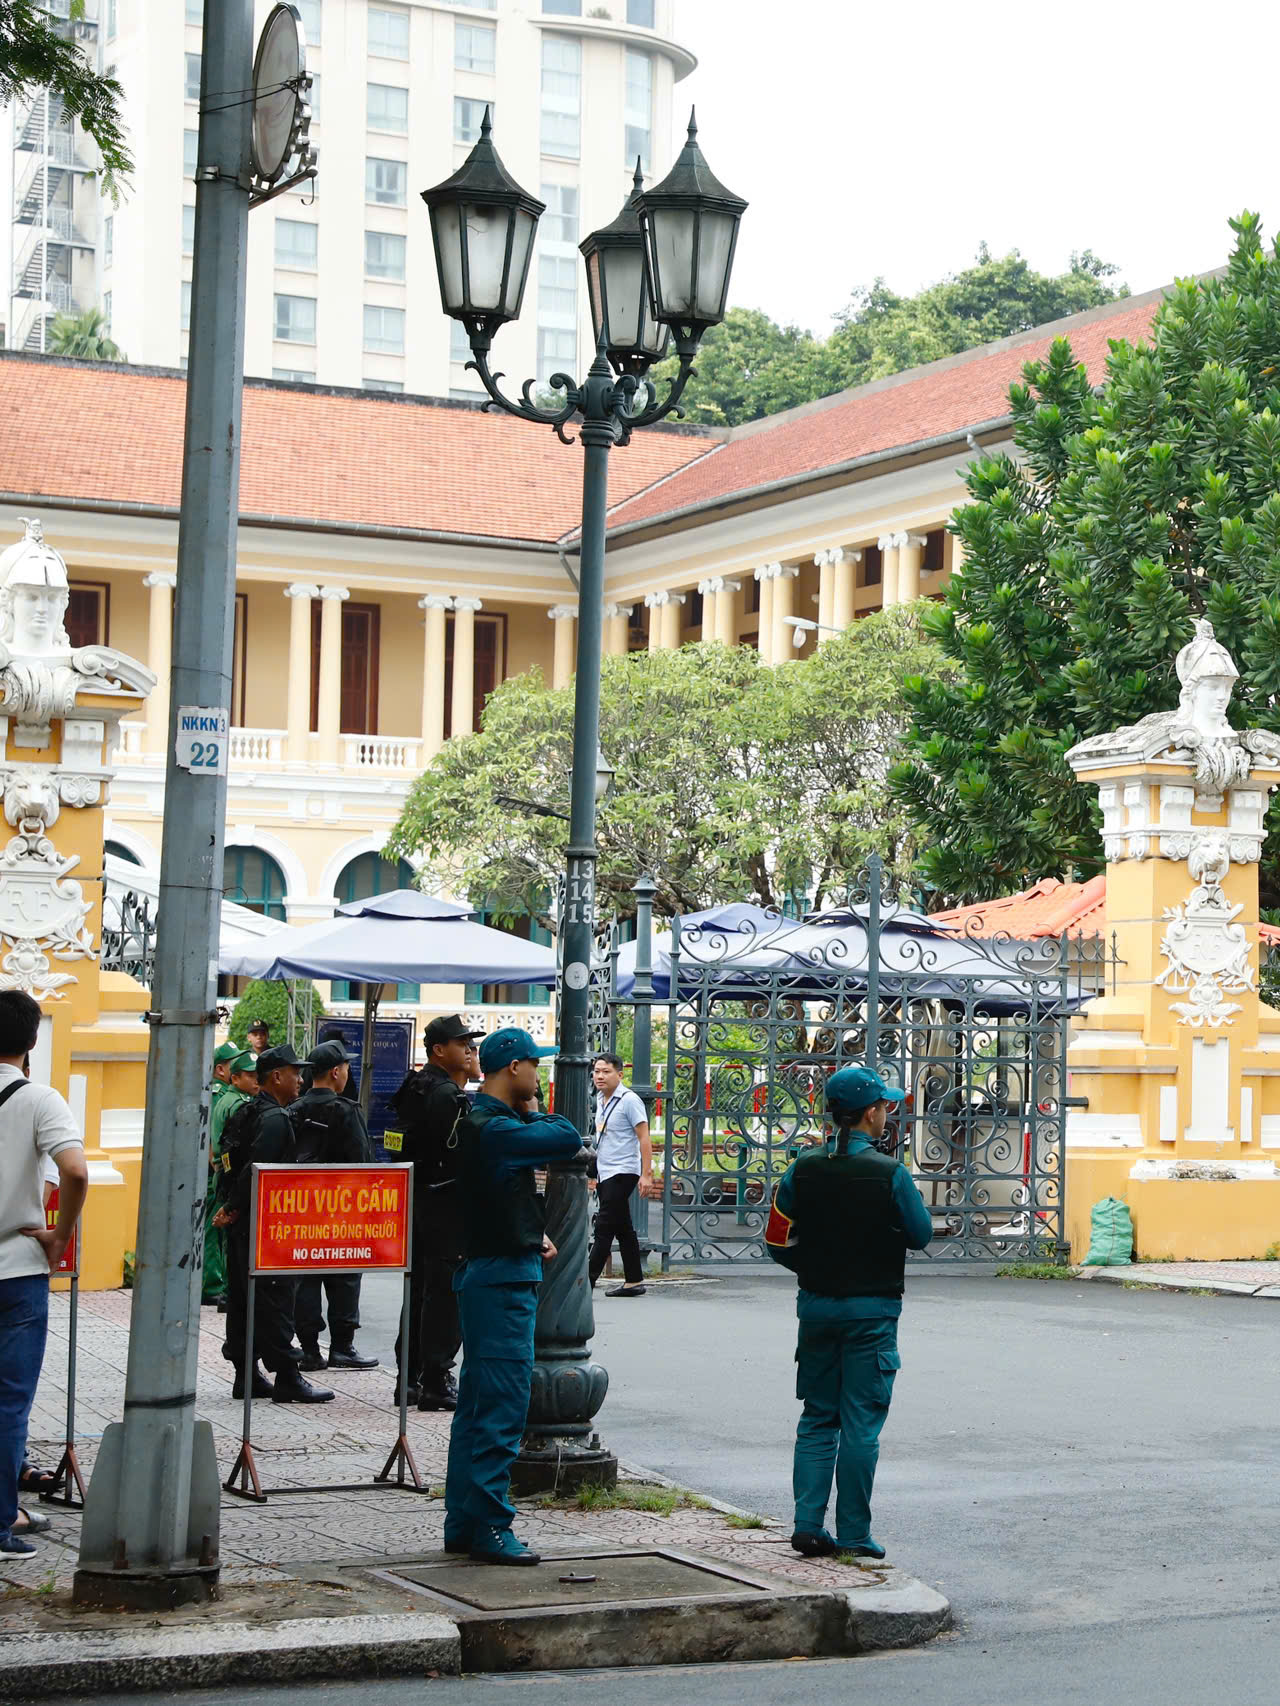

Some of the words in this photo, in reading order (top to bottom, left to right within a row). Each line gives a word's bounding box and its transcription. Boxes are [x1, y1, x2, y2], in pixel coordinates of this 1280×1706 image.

[182, 716, 218, 732] NKKN
[221, 719, 226, 732] 3
[190, 742, 219, 767] 22
[571, 859, 593, 880] 13
[571, 881, 593, 901] 14
[568, 903, 593, 924] 15
[269, 1190, 309, 1213] KHU
[314, 1185, 352, 1218] VỰC
[357, 1179, 398, 1213] CẤM
[269, 1221, 291, 1243] TẬP
[294, 1224, 330, 1240] TRUNG
[332, 1220, 362, 1240] ĐÔNG
[365, 1220, 397, 1240] NGƯỜI
[293, 1248, 308, 1260] NO
[310, 1247, 372, 1260] GATHERING
